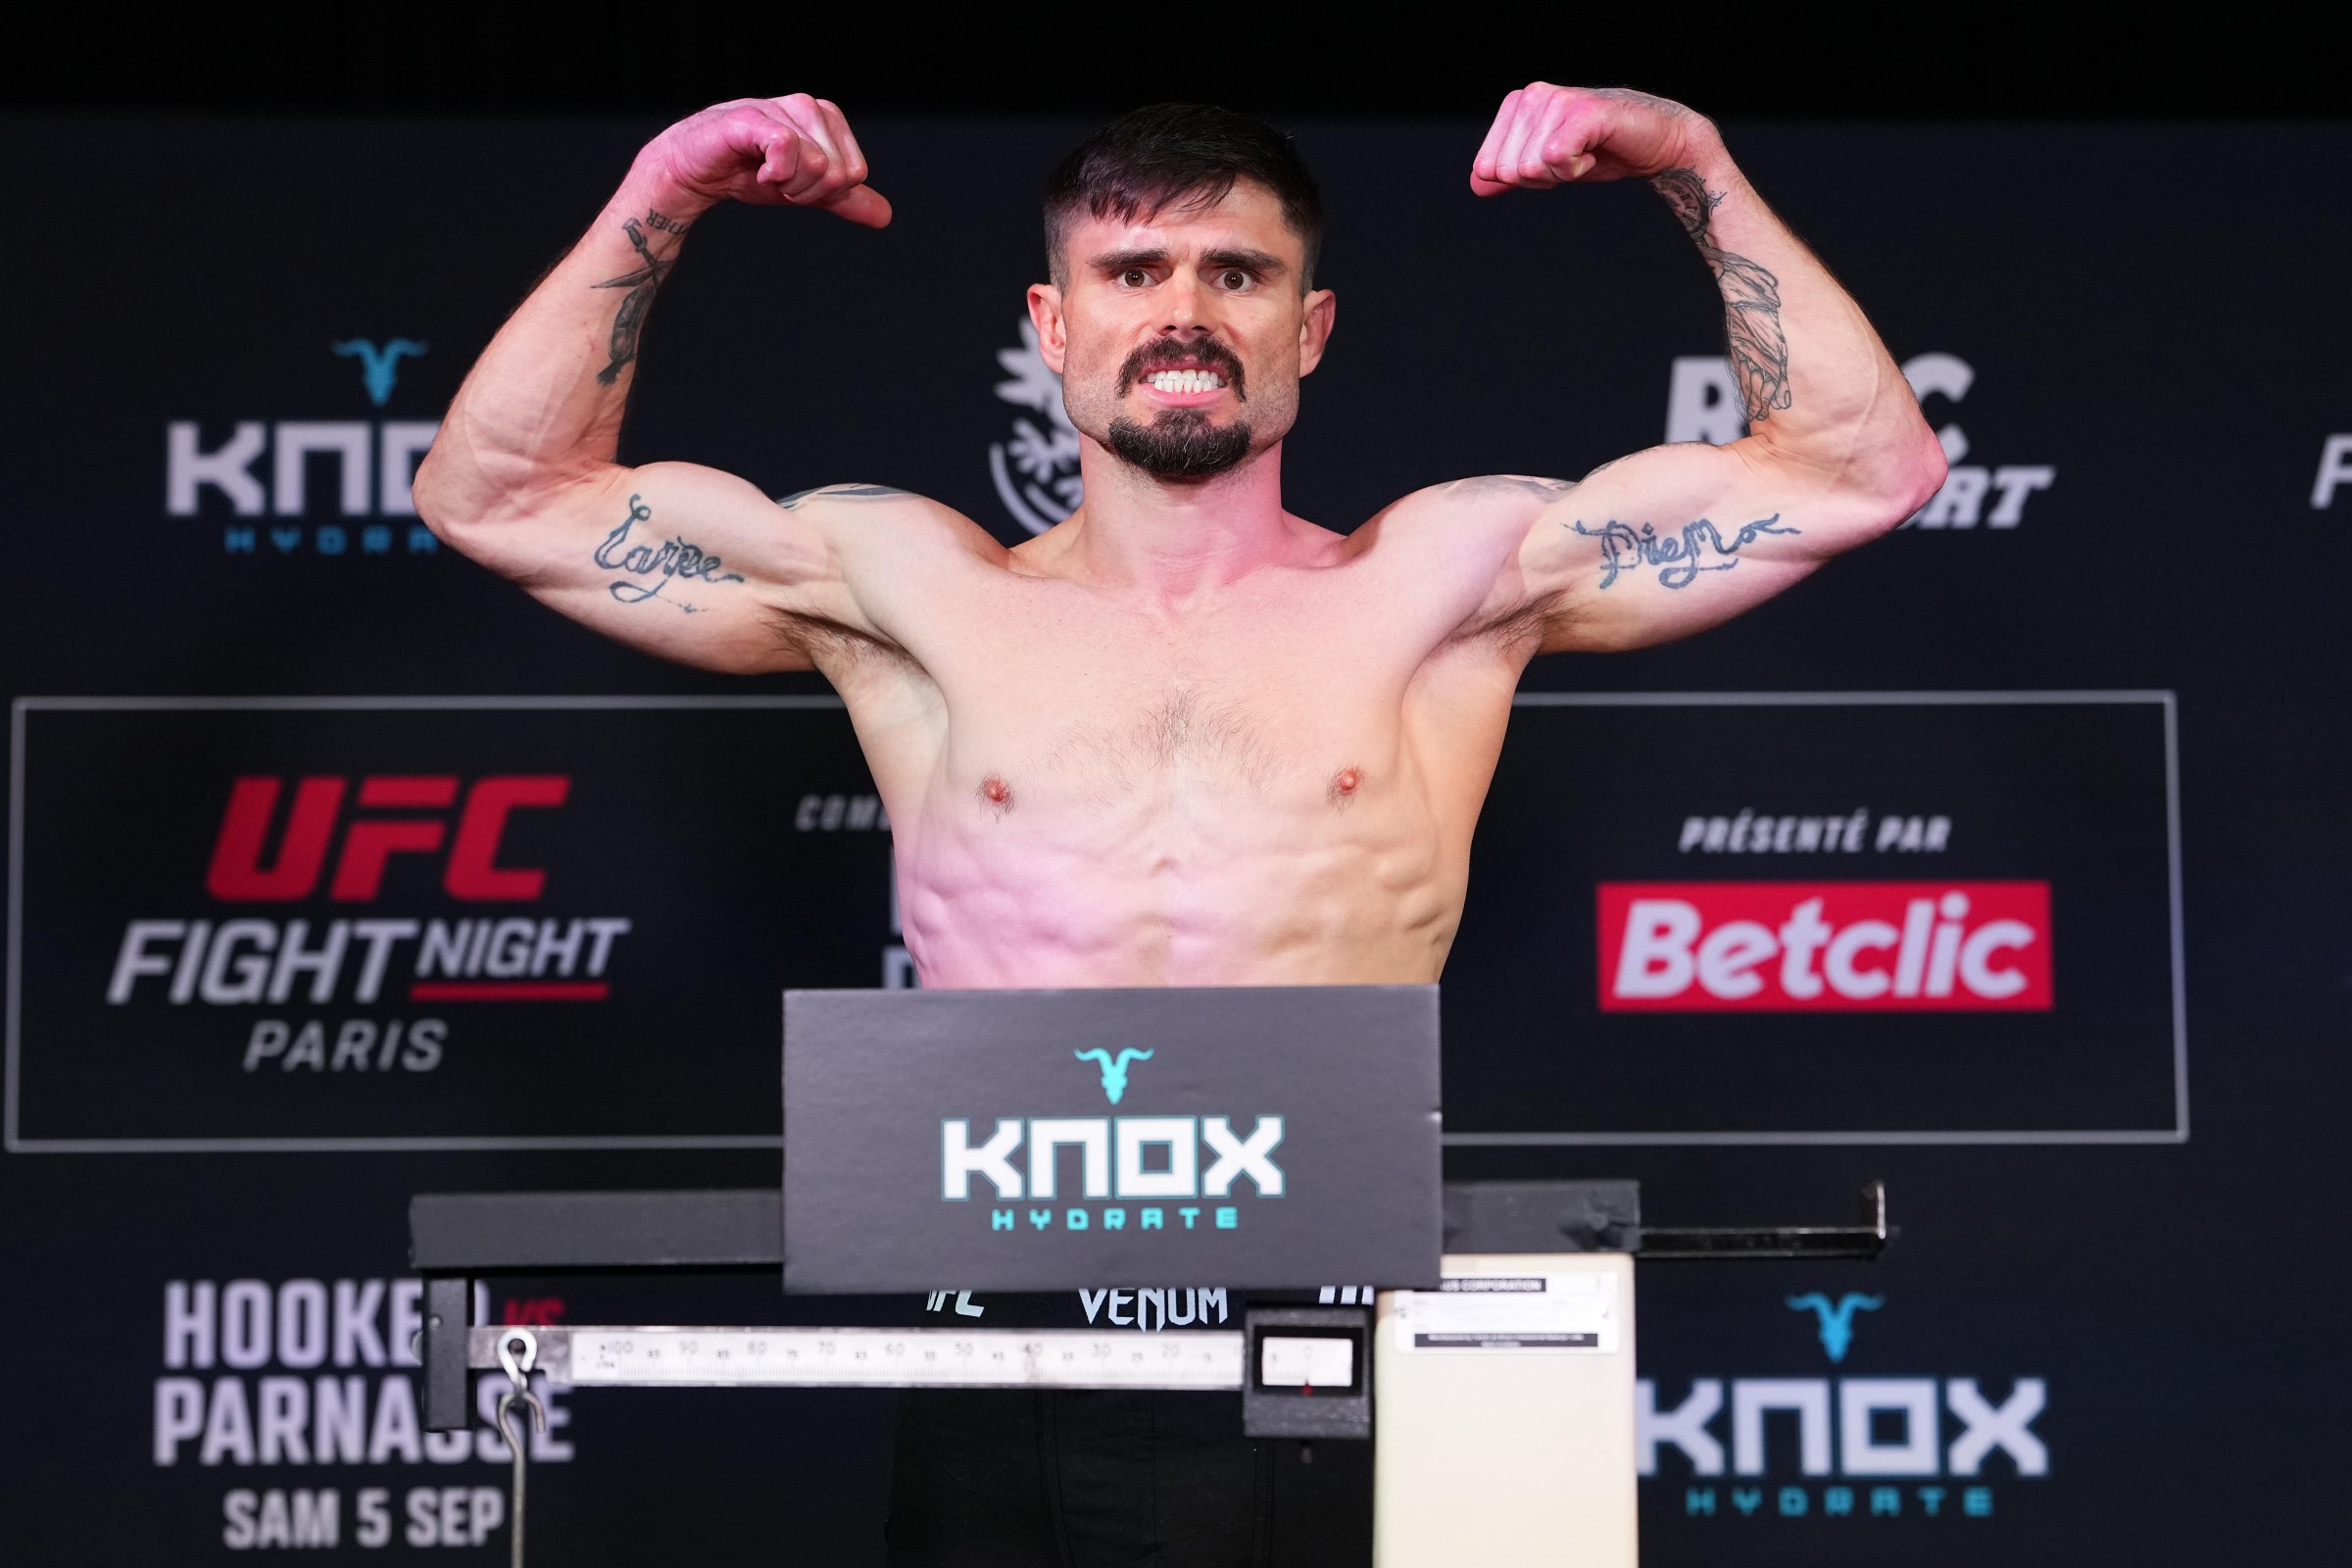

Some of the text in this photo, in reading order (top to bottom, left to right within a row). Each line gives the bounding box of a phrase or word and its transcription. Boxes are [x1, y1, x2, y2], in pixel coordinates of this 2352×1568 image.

[208, 775, 570, 901] UFC
[1680, 808, 1952, 853] PRÉSENTÉ PAR
[109, 917, 630, 1005] FIGHT NIGHT
[1613, 891, 2036, 1000] Betclic
[244, 1019, 448, 1072] PARIS
[940, 1115, 1285, 1201] KNOX
[992, 1207, 1238, 1231] HYDRATE
[165, 1278, 489, 1369] HOOKE
[1078, 1287, 1228, 1333] VENUM
[1639, 1377, 2048, 1478] KNOX
[223, 1486, 504, 1550] SAM 5 SEP
[1687, 1486, 1992, 1517] HYDRATE
